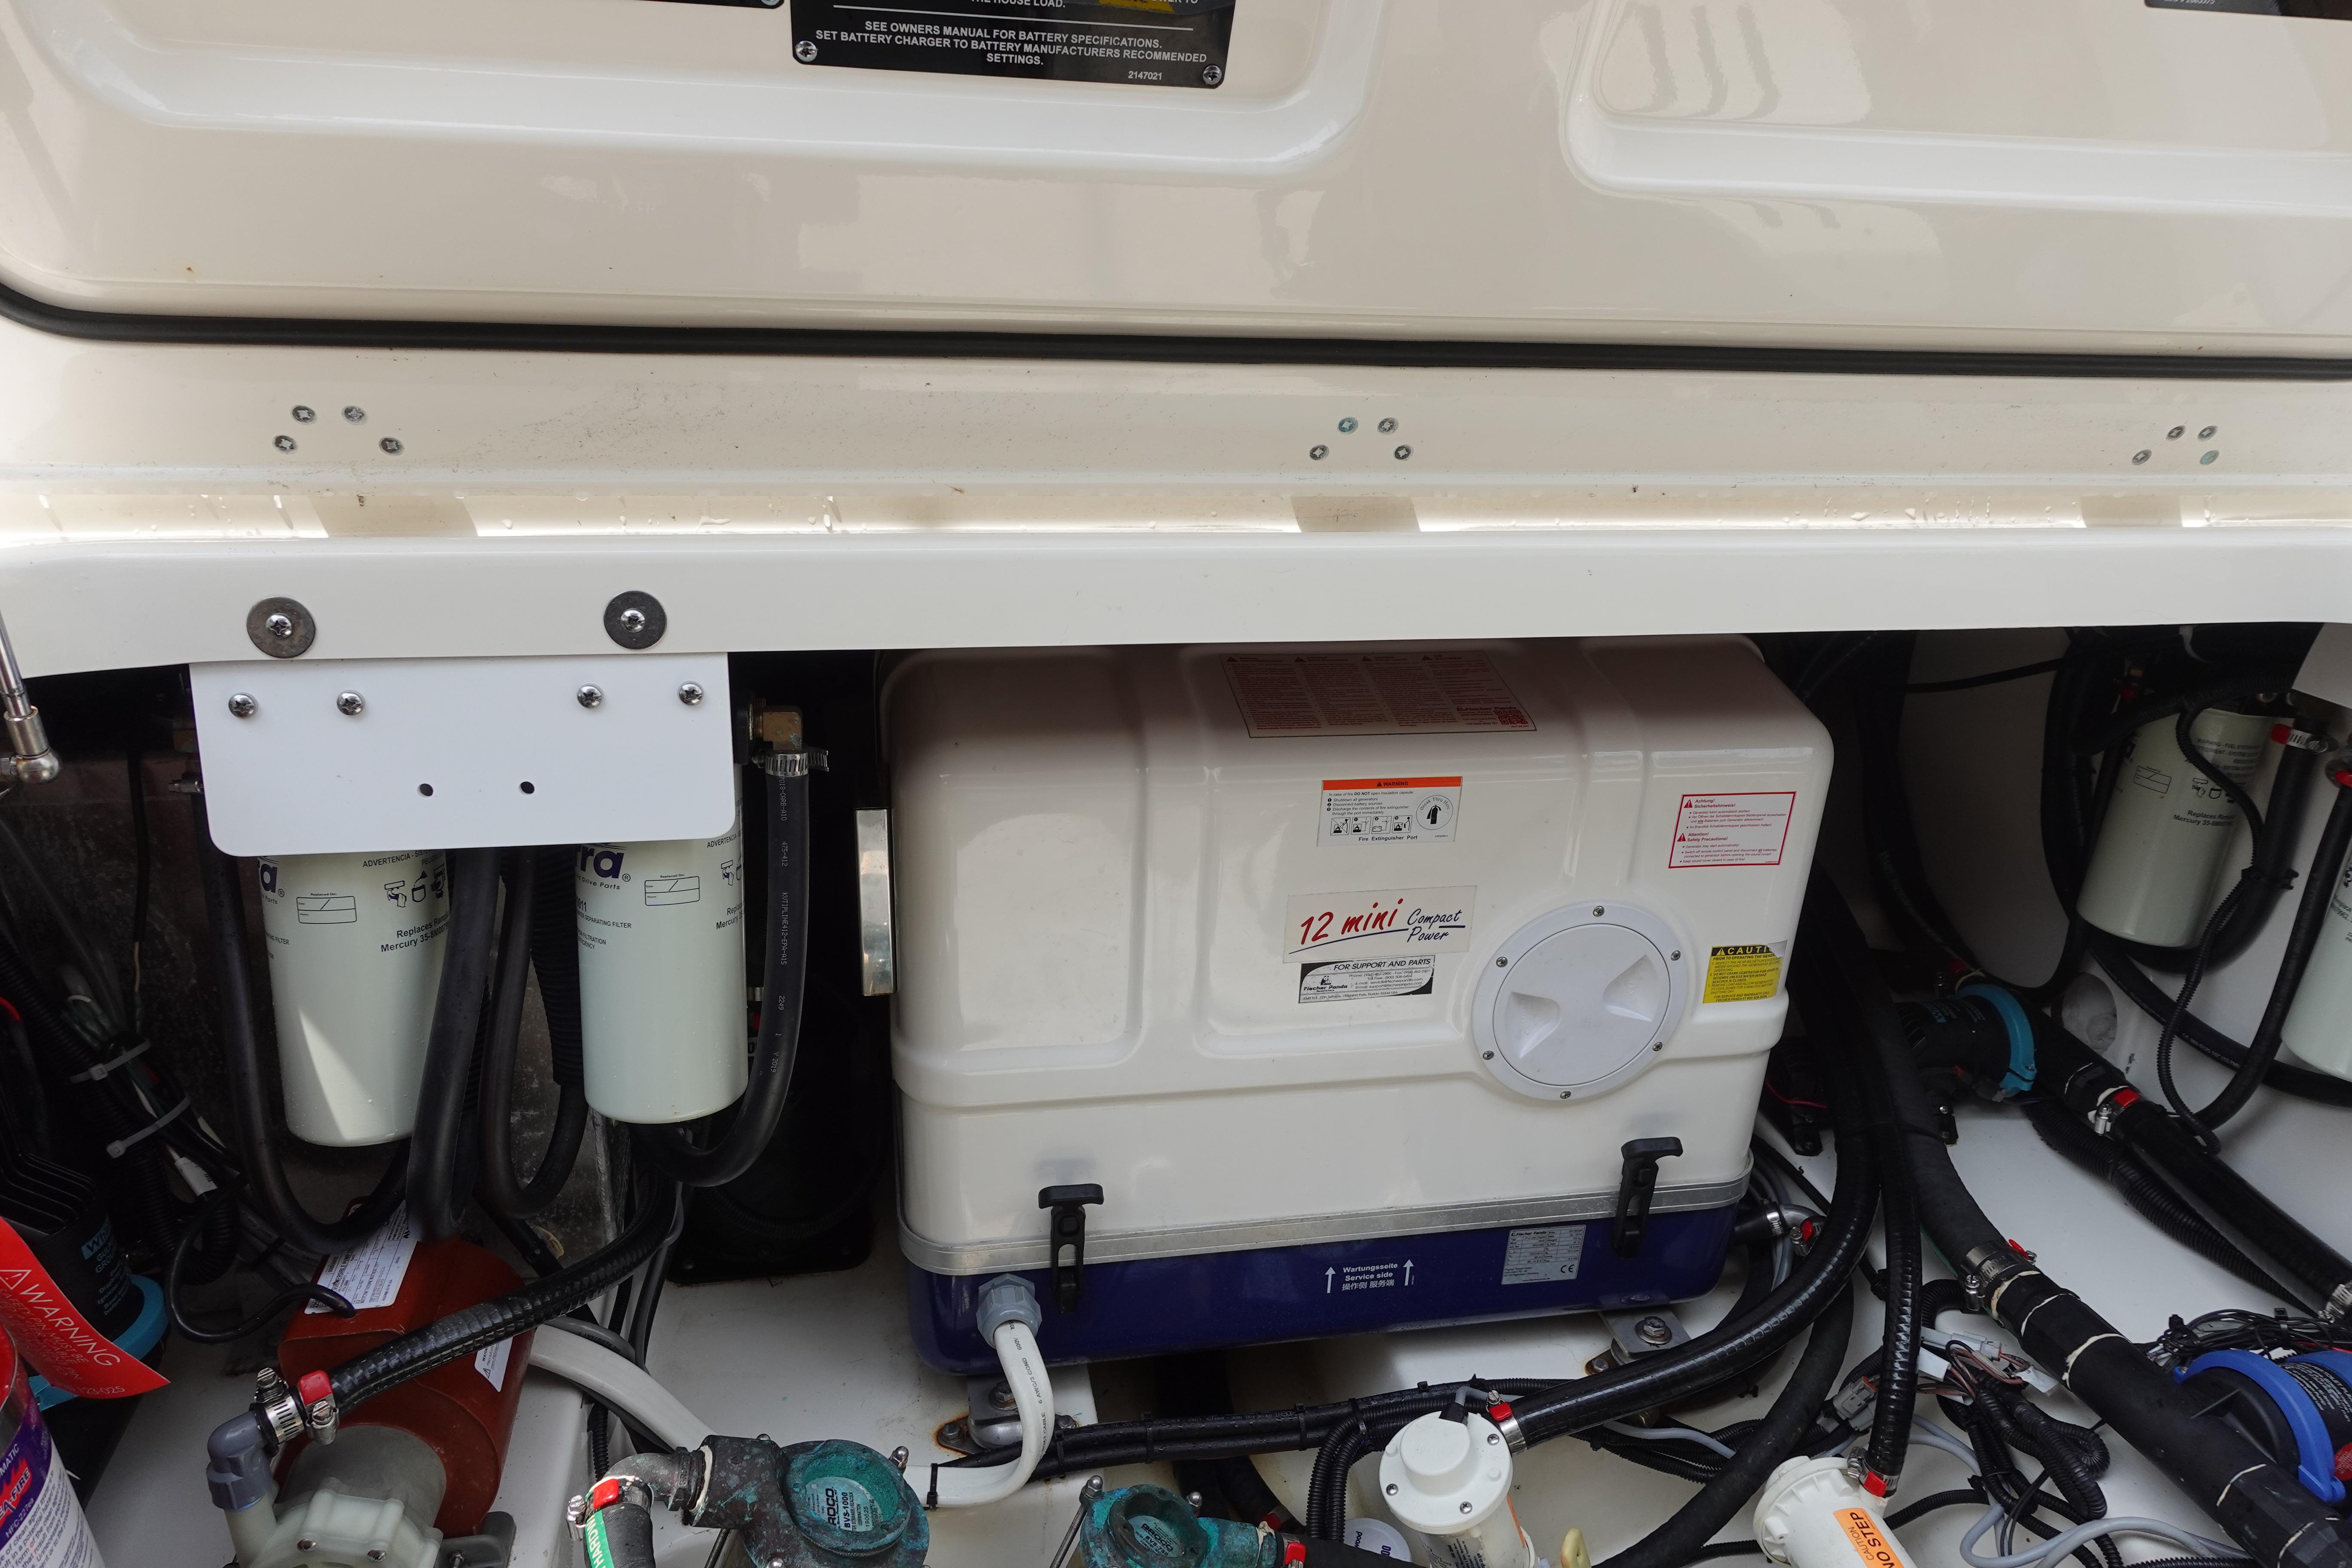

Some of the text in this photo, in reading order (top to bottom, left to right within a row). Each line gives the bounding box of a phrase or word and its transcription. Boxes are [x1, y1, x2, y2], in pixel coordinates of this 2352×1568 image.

[865, 21, 1162, 49] SEE OWNERS MANUAL FOR BATTERY SPECIFICATIONS.
[816, 30, 1207, 63] SET BATTERY CHARGER TO BATTERY MANUFACTURERS RECOMMENDED
[986, 53, 1044, 65] SETTINGS.
[1128, 71, 1162, 80] 2147021
[1420, 799, 1431, 811] Break
[2173, 814, 2201, 826] Mercury
[2187, 810, 2216, 819] Replaces
[707, 834, 737, 848] ADVERTENCIA
[363, 853, 411, 867] ADVERTENCIA
[582, 876, 597, 886] Drive
[265, 895, 278, 904] Parts
[585, 915, 611, 927] SEPARATING
[716, 914, 738, 929] Mercury
[1301, 898, 1403, 945] 12 mini
[1407, 908, 1462, 930] Compact
[396, 922, 432, 938] Replaces
[1407, 926, 1449, 943] Power
[275, 936, 290, 945] FILTER
[381, 938, 418, 952] Mercury
[582, 932, 606, 945] FILTRATION
[770, 1058, 779, 1073] 2019
[1343, 1263, 1398, 1273] Wartungsseite
[1341, 1279, 1395, 1291] 操作侧 服务端
[19, 1283, 121, 1366] WARNING
[1022, 1358, 1032, 1375] COND
[1030, 1376, 1041, 1398] AWG/3
[5, 1498, 35, 1538] HFC-227ea
[842, 1492, 851, 1528] BVS-1000
[6, 1504, 41, 1555] of clean agent
[11, 1551, 18, 1559] in
[23, 1513, 43, 1546] potential
[1850, 1512, 1881, 1547] STEP
[15, 1548, 30, 1564] form
[30, 1538, 37, 1548] of
[36, 1528, 44, 1540] the
[34, 1533, 47, 1554] result
[1142, 1523, 1174, 1553] GROCO
[1145, 1535, 1169, 1556] BVS-750
[1848, 1527, 1874, 1560] CAUTION
